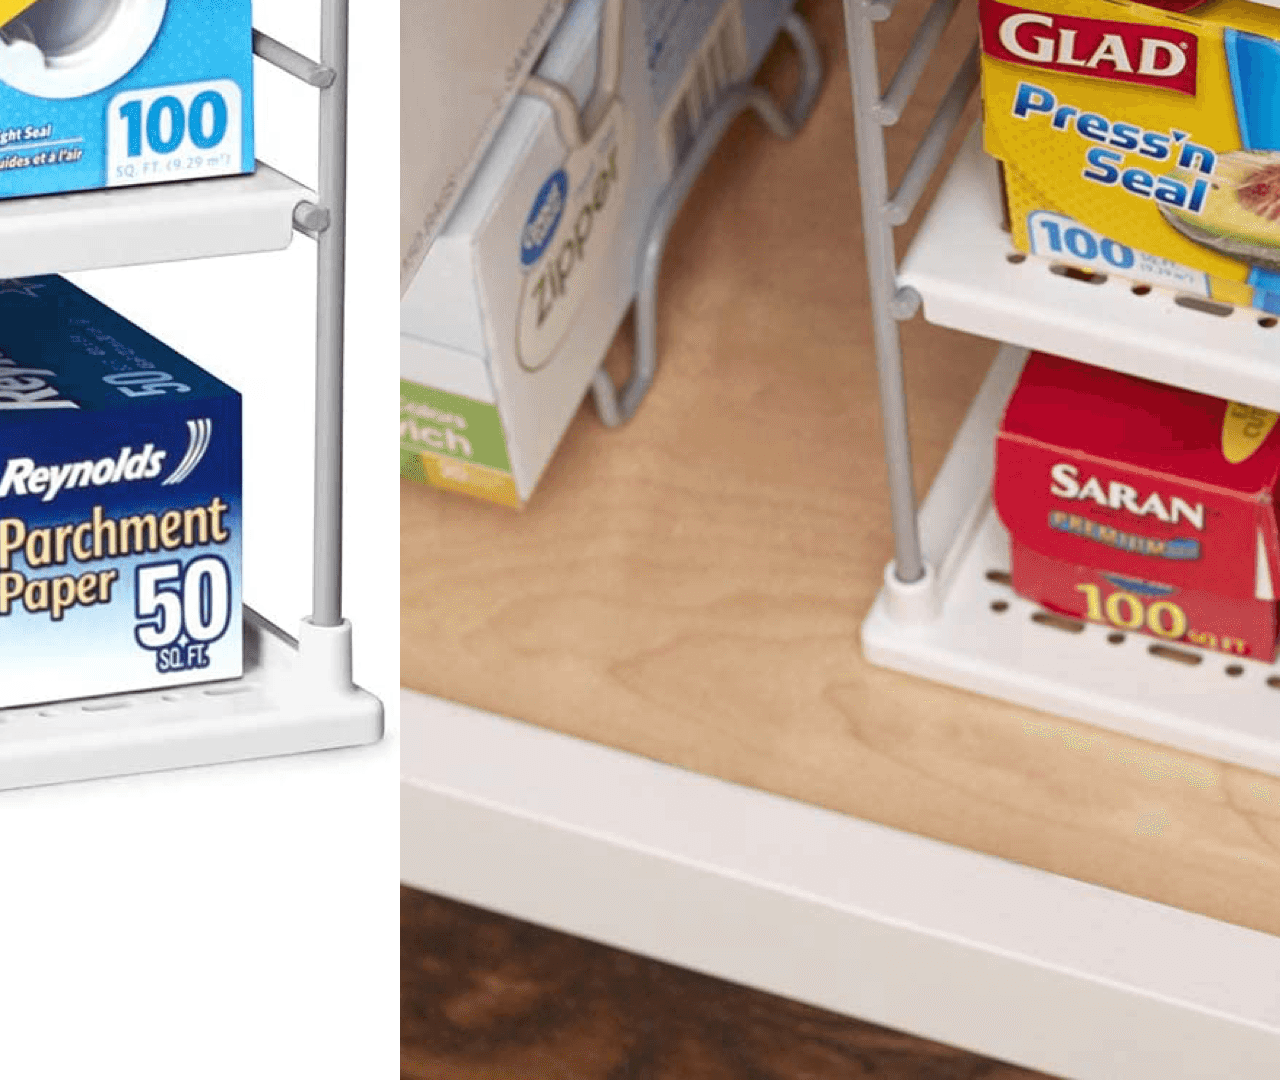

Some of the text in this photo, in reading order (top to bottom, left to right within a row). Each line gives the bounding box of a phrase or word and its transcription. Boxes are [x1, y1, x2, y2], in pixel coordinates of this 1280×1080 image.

[998, 12, 1187, 78] GLAD
[24, 124, 52, 140] Seal
[119, 89, 228, 158] 100
[1012, 82, 1218, 176] Press'n
[33, 153, 46, 165] et
[1082, 149, 1210, 214] Seal
[1039, 220, 1135, 269] 100
[102, 370, 192, 398] 50
[1050, 463, 1204, 531] SARAN
[134, 554, 232, 650] 50
[1075, 583, 1187, 639] 100
